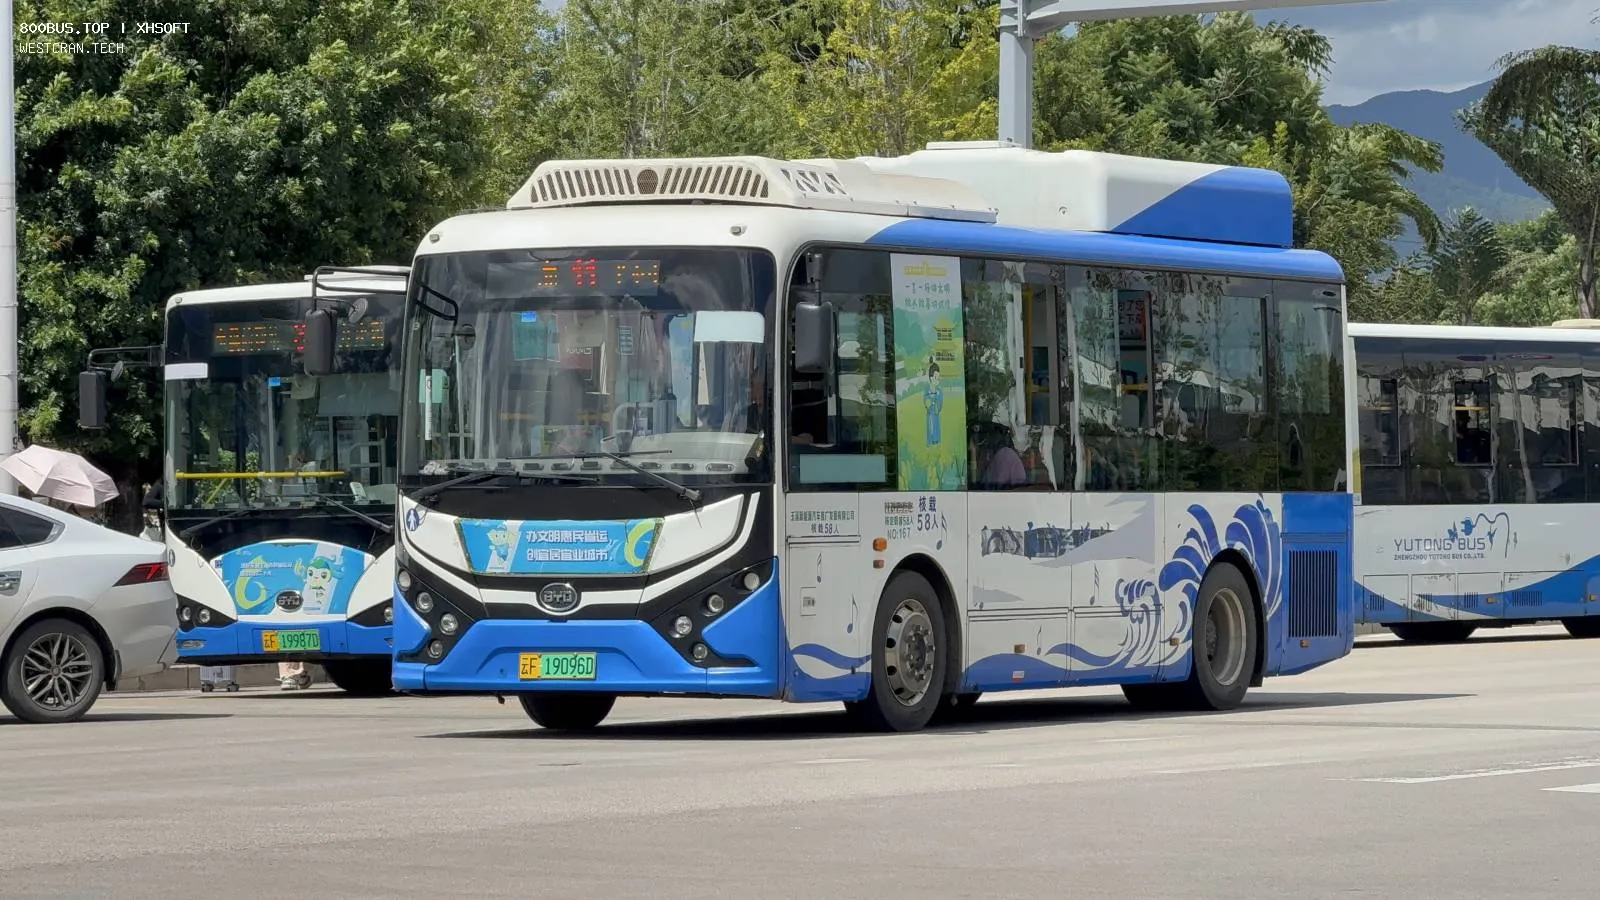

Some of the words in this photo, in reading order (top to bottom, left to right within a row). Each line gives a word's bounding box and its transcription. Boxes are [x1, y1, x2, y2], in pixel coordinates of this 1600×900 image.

[918, 496, 937, 513] 核载
[916, 513, 939, 532] 58人
[1393, 538, 1453, 552] YUTONG
[1458, 537, 1486, 551] BUS
[543, 590, 573, 603] BYD
